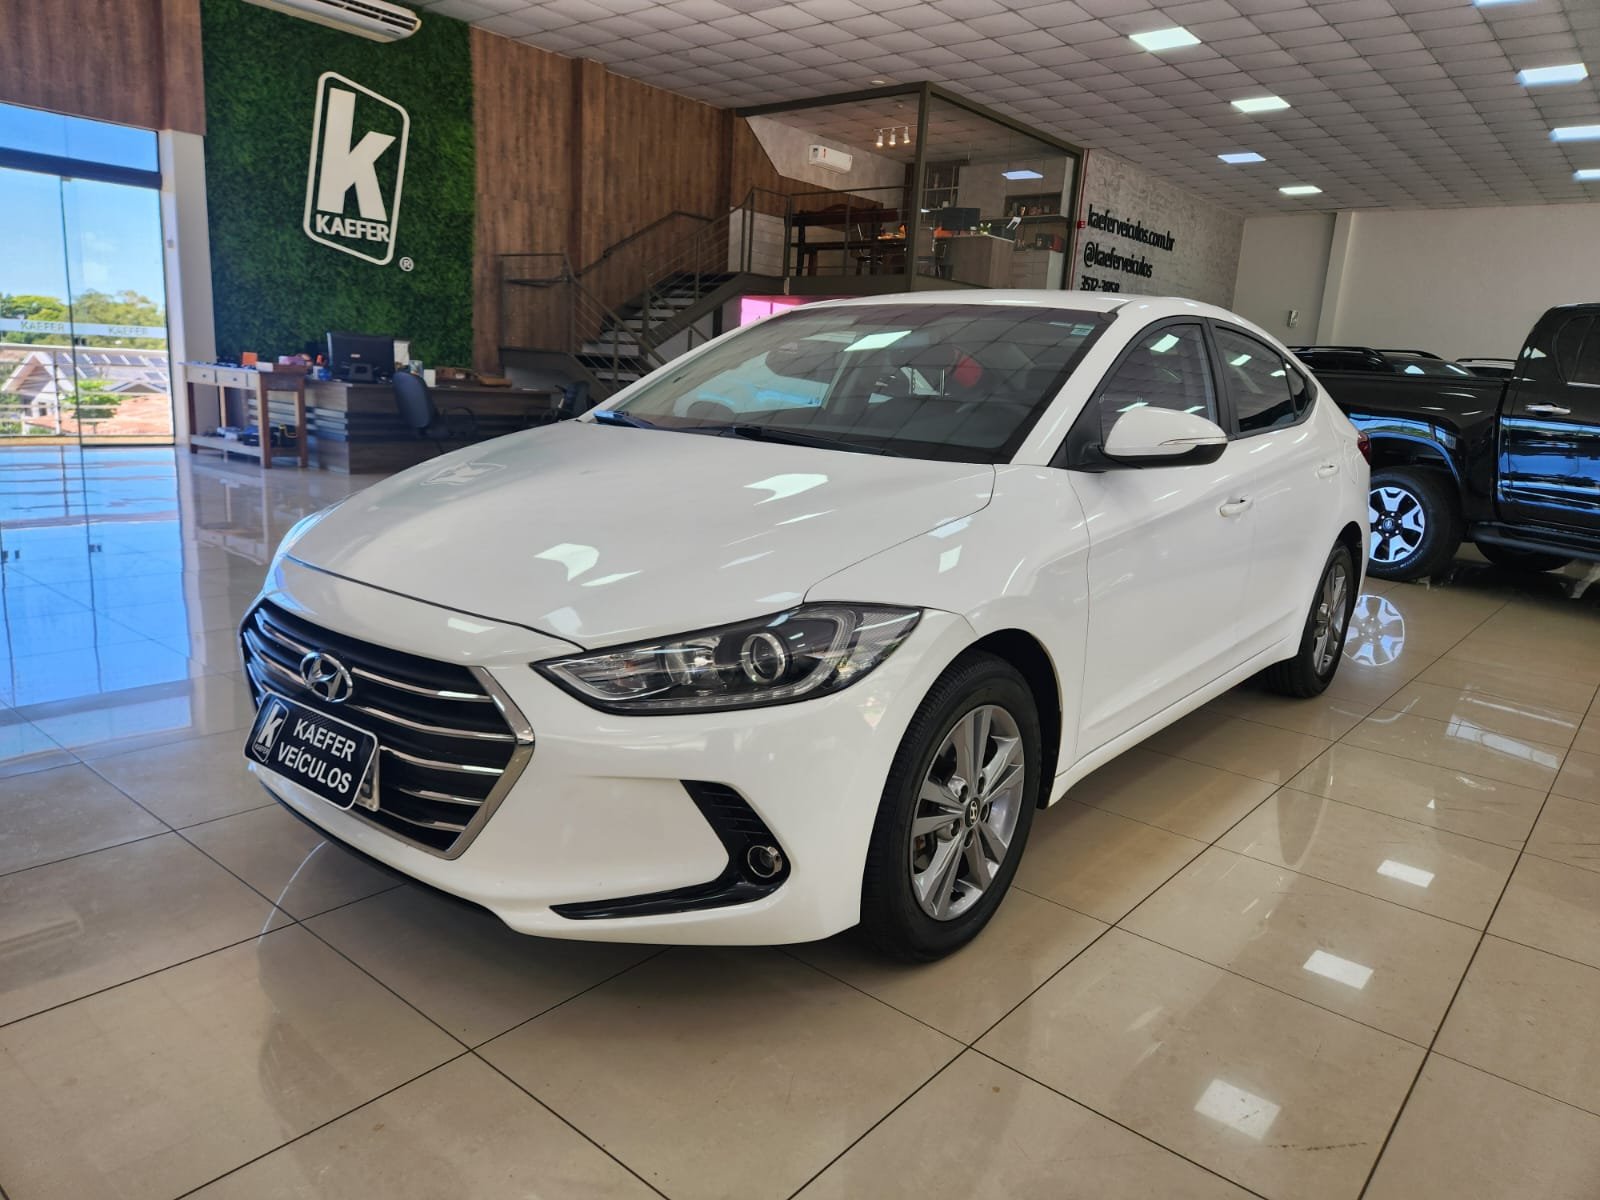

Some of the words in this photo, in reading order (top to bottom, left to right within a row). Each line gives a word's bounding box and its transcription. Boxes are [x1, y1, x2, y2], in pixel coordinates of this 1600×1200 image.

[315, 213, 390, 242] KAEFER
[1088, 203, 1175, 252] kaeferveiculos.com.br
[1083, 241, 1153, 278] @kaeferveiculos
[20, 320, 65, 332] KAEFER
[293, 718, 357, 762] KAEFER
[277, 741, 352, 794] VEÍCULOS
